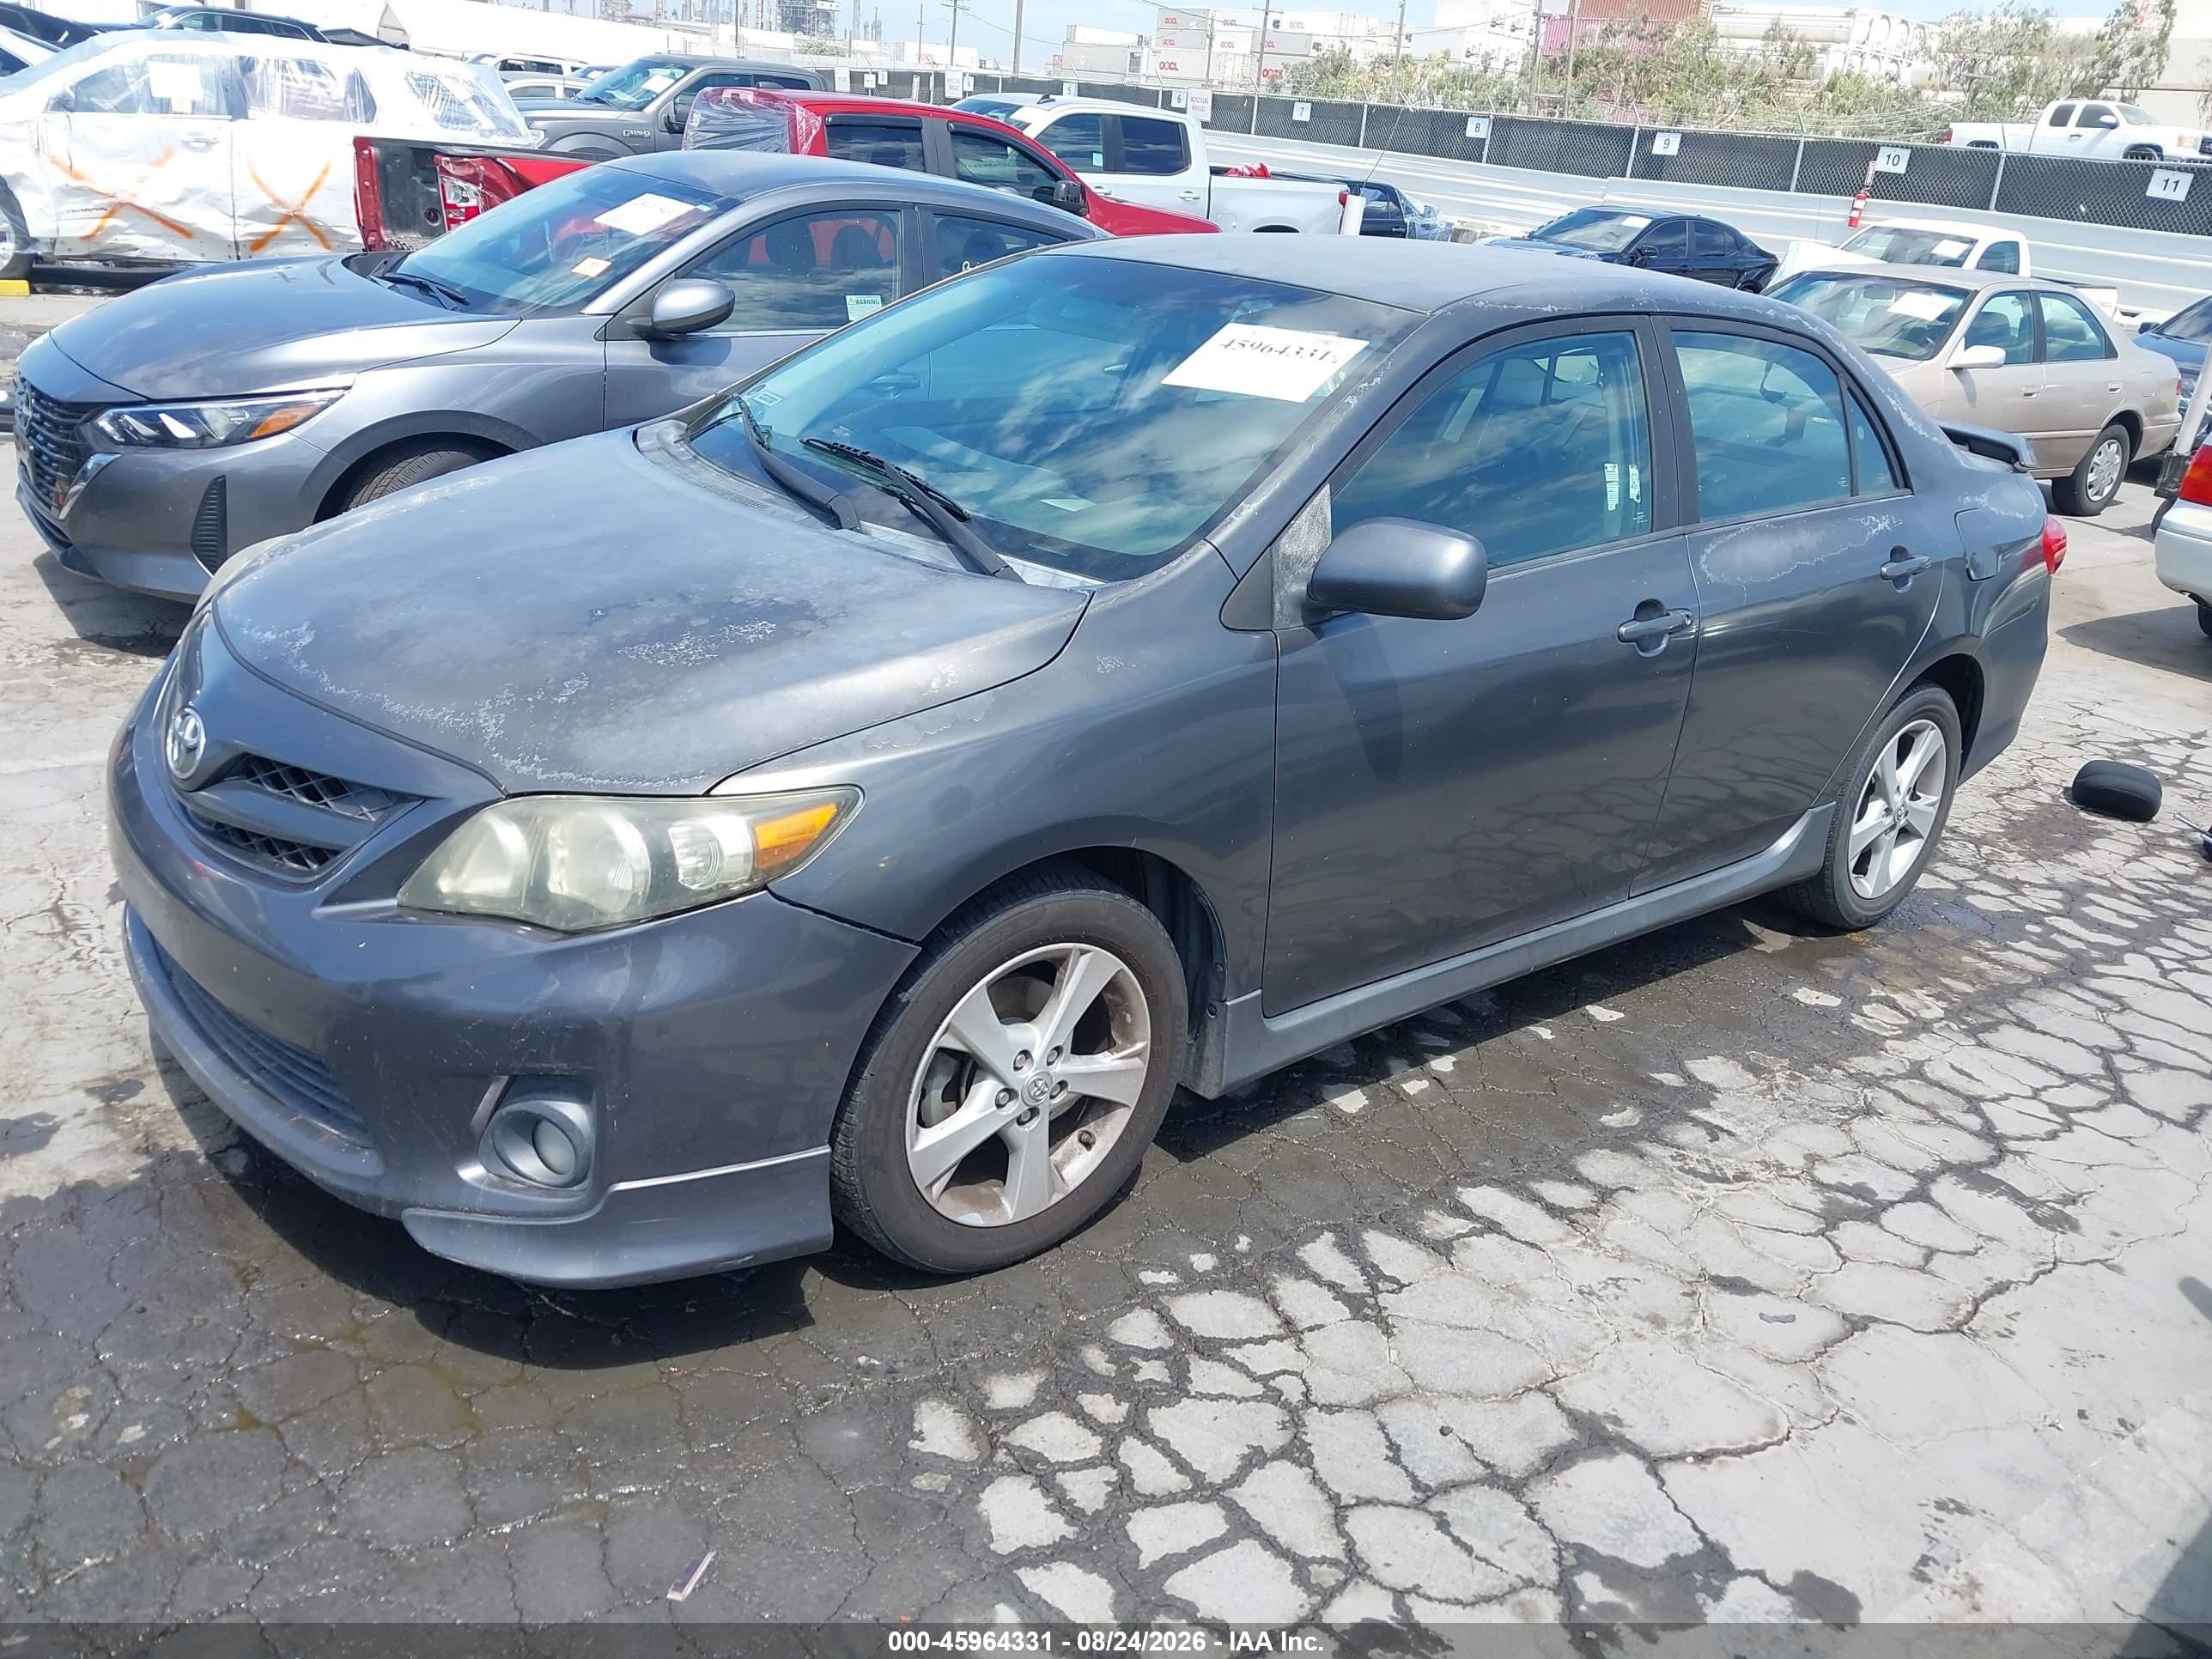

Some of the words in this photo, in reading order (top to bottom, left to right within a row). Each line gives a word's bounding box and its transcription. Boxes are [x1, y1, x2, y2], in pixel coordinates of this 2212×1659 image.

[1159, 61, 1178, 70] OOCL
[1176, 94, 1182, 103] 6
[1299, 107, 1304, 116] 7
[1474, 122, 1480, 133] 8
[1663, 137, 1670, 149] 9
[1886, 153, 1900, 167] 10
[2163, 177, 2180, 193] 11
[1219, 338, 1333, 362] 45964331
